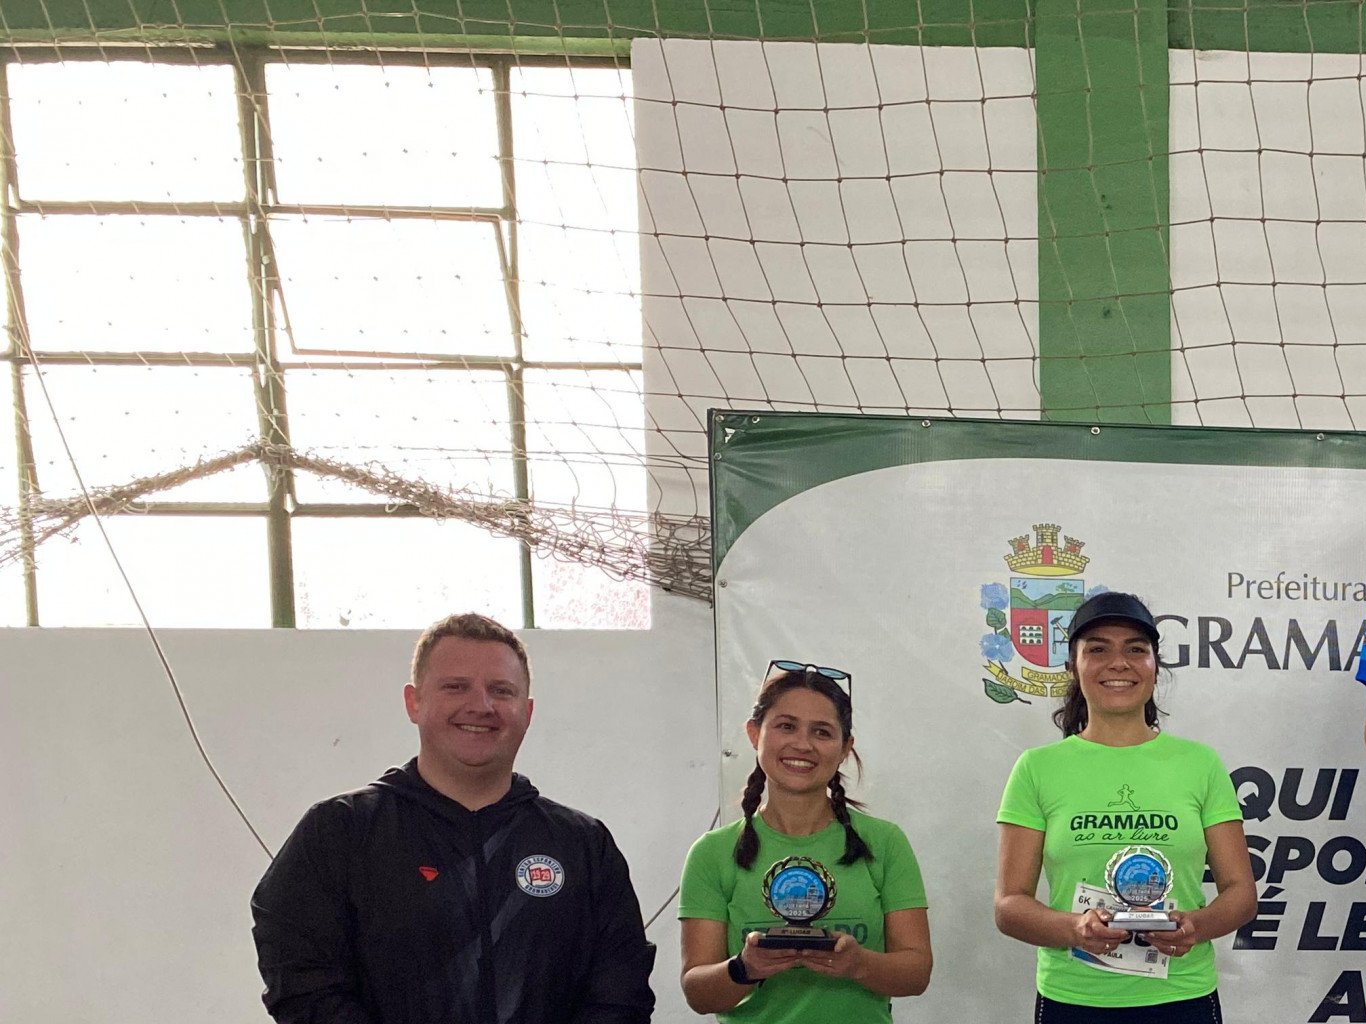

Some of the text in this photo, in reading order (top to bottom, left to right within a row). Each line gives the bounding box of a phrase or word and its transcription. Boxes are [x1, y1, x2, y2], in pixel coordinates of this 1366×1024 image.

[1229, 766, 1360, 822] QUI
[1070, 813, 1179, 831] GRAMADO
[1074, 827, 1169, 842] ao ar livre
[1078, 895, 1091, 906] 6K
[1232, 885, 1287, 951] É
